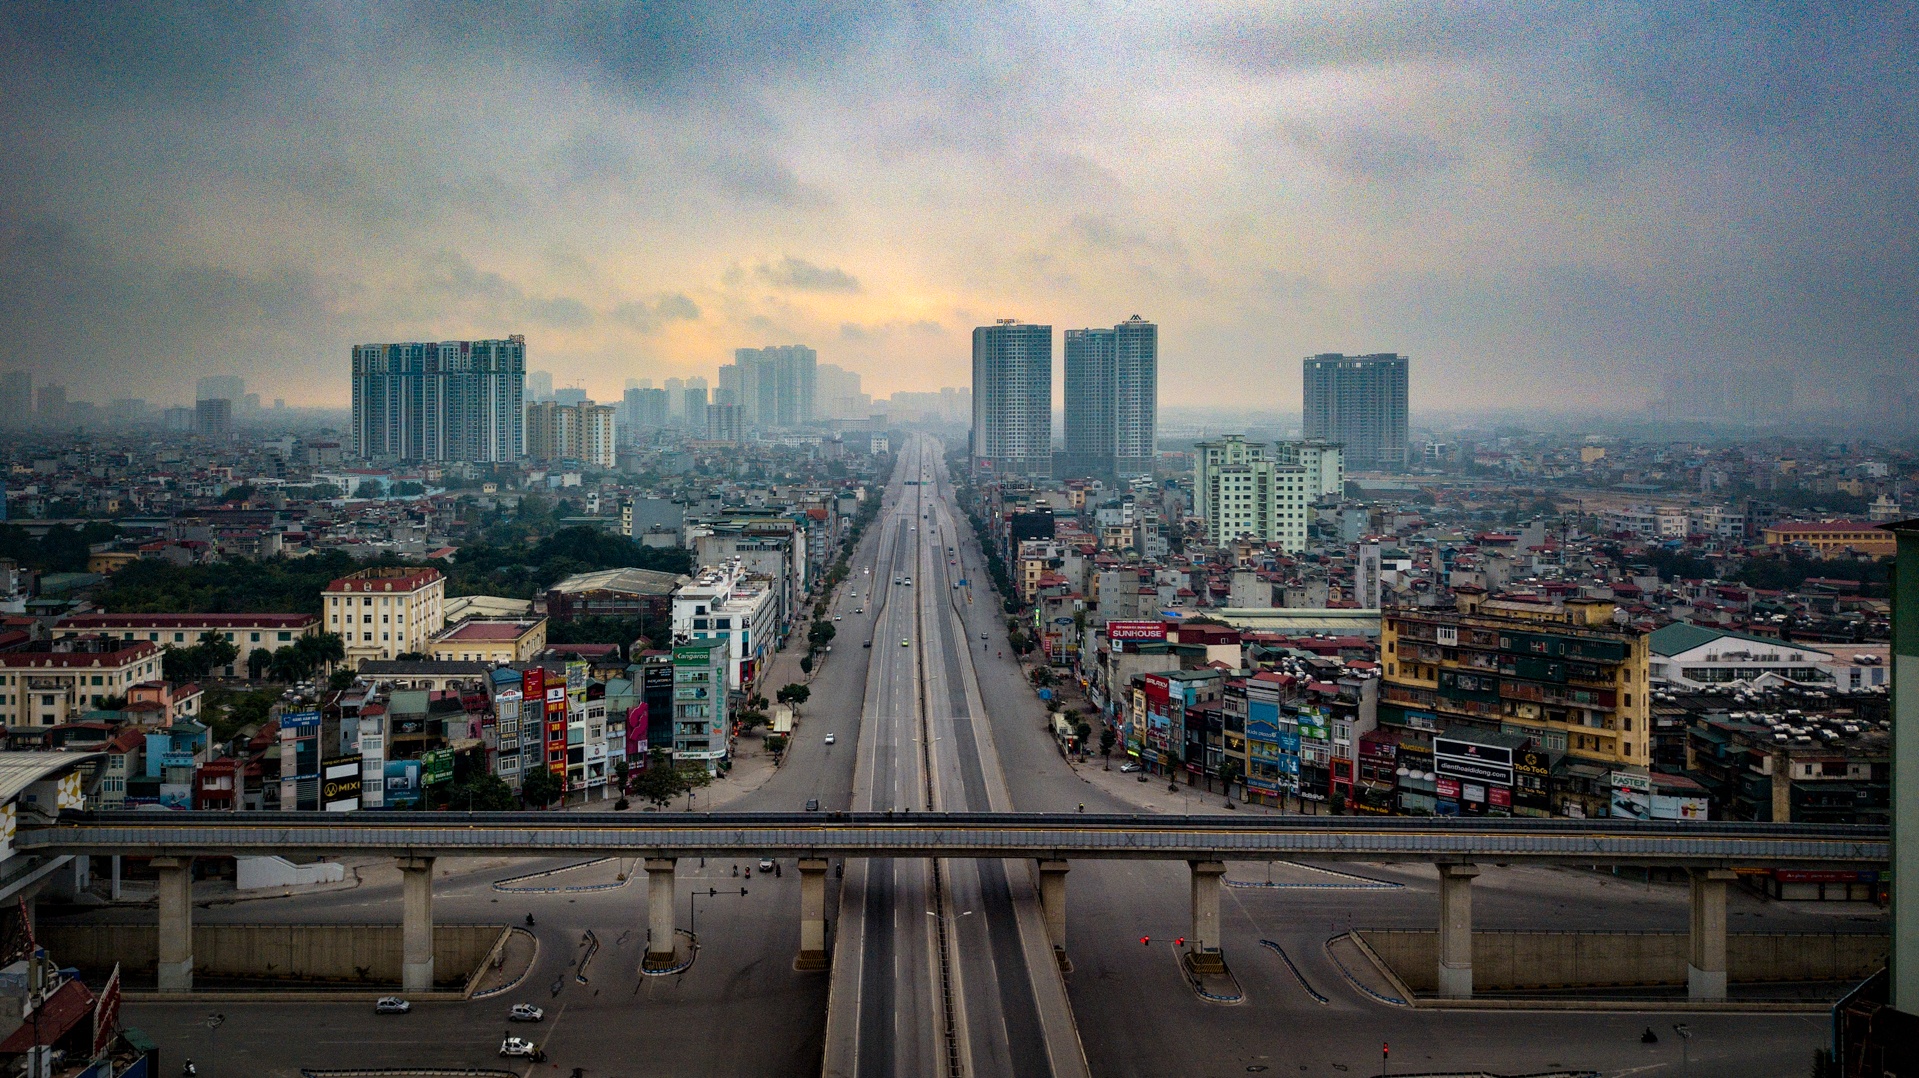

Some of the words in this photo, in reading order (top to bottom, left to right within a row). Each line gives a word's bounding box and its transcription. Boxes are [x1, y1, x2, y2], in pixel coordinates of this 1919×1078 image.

[675, 652, 709, 661] Kangaroo
[713, 667, 723, 734] Kangaroo
[338, 781, 361, 793] MIXI
[1613, 776, 1646, 787] FASTER
